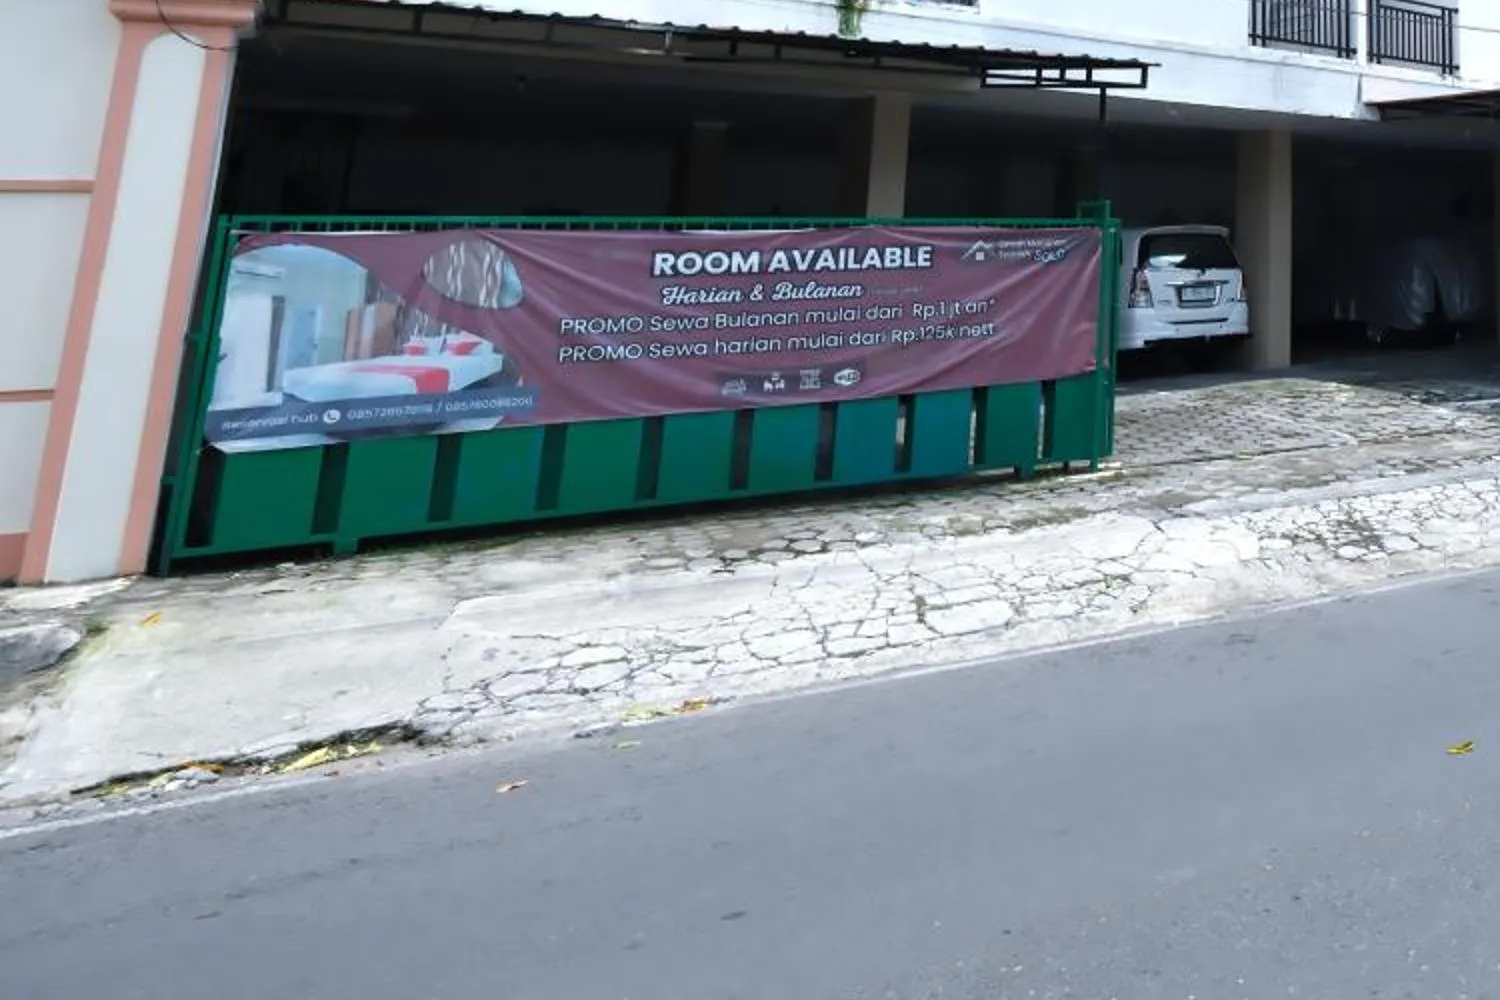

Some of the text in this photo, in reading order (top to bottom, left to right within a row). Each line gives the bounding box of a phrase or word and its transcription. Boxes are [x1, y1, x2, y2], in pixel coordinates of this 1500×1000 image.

[653, 245, 932, 275] ROOM AVAILABLE
[662, 286, 742, 305] Harian
[750, 284, 763, 301] &
[772, 281, 863, 301] Bulanan
[560, 317, 643, 334] PROMO
[650, 315, 709, 332] Sewa
[715, 312, 799, 329] Bulanan
[805, 306, 860, 323] mulai
[865, 304, 902, 320] dari
[559, 344, 642, 362] PROMO
[649, 342, 708, 358] Sewa
[715, 337, 781, 354] harian
[787, 332, 843, 349] mulai
[959, 323, 994, 337] nett
